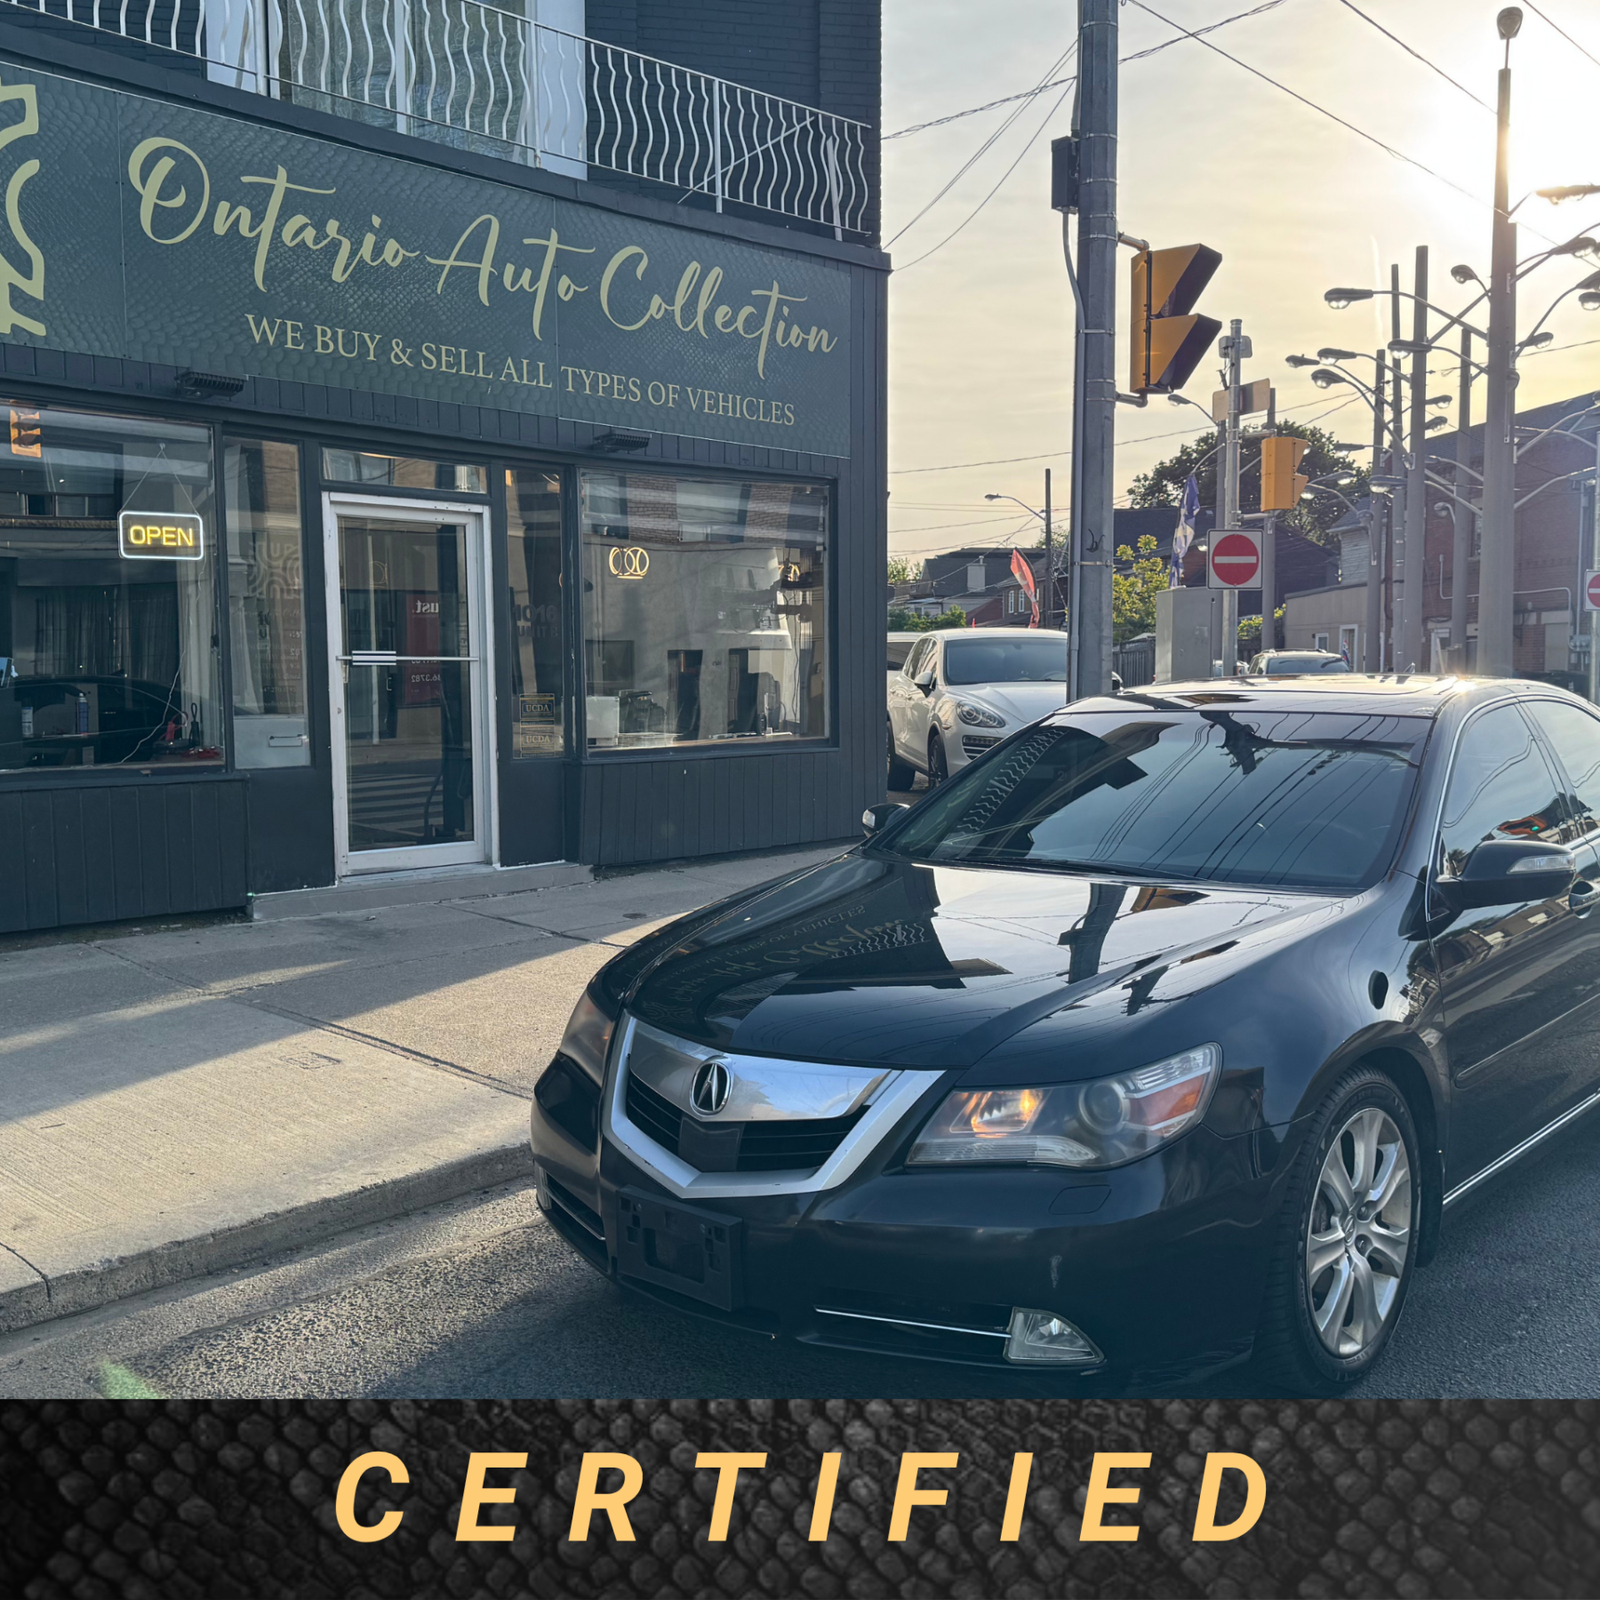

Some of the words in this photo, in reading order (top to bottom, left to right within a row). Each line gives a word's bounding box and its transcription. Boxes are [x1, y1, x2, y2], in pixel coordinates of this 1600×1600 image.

[128, 137, 420, 293] Ontario
[425, 213, 596, 341] Auto
[600, 245, 838, 380] Collection
[245, 313, 304, 350] WE
[314, 325, 382, 361] BUY
[390, 338, 414, 367] &
[421, 343, 494, 379] SELL
[499, 356, 553, 389] ALL
[560, 366, 640, 402] TYPES
[648, 380, 681, 407] OF
[685, 387, 795, 426] VEHICLES
[129, 525, 194, 547] OPEN
[525, 704, 550, 712] UCDA
[525, 735, 551, 743] UCDA
